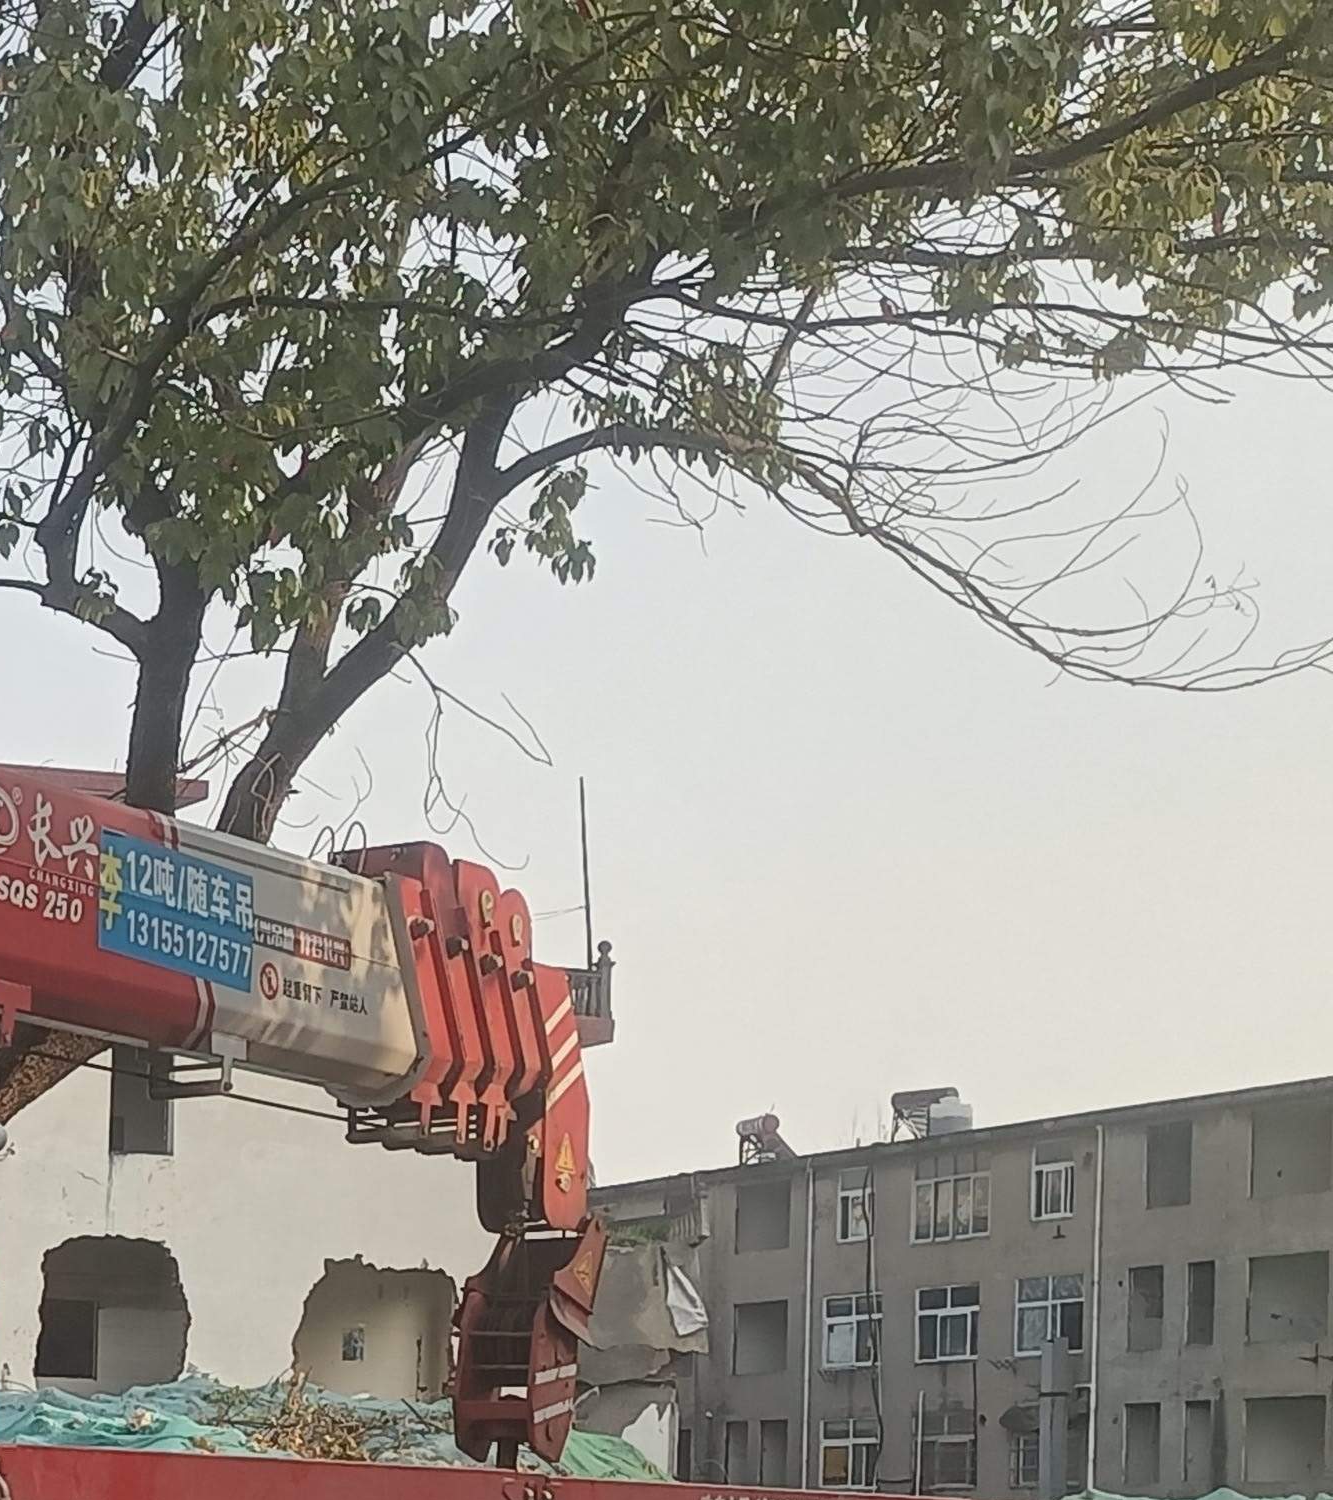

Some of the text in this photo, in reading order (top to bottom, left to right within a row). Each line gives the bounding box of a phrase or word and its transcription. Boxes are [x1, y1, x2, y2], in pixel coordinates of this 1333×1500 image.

[29, 868, 95, 897] CHANGXING
[42, 890, 83, 923] 250
[127, 850, 253, 933] 12吨/随车吊
[127, 909, 252, 978] 13155127577
